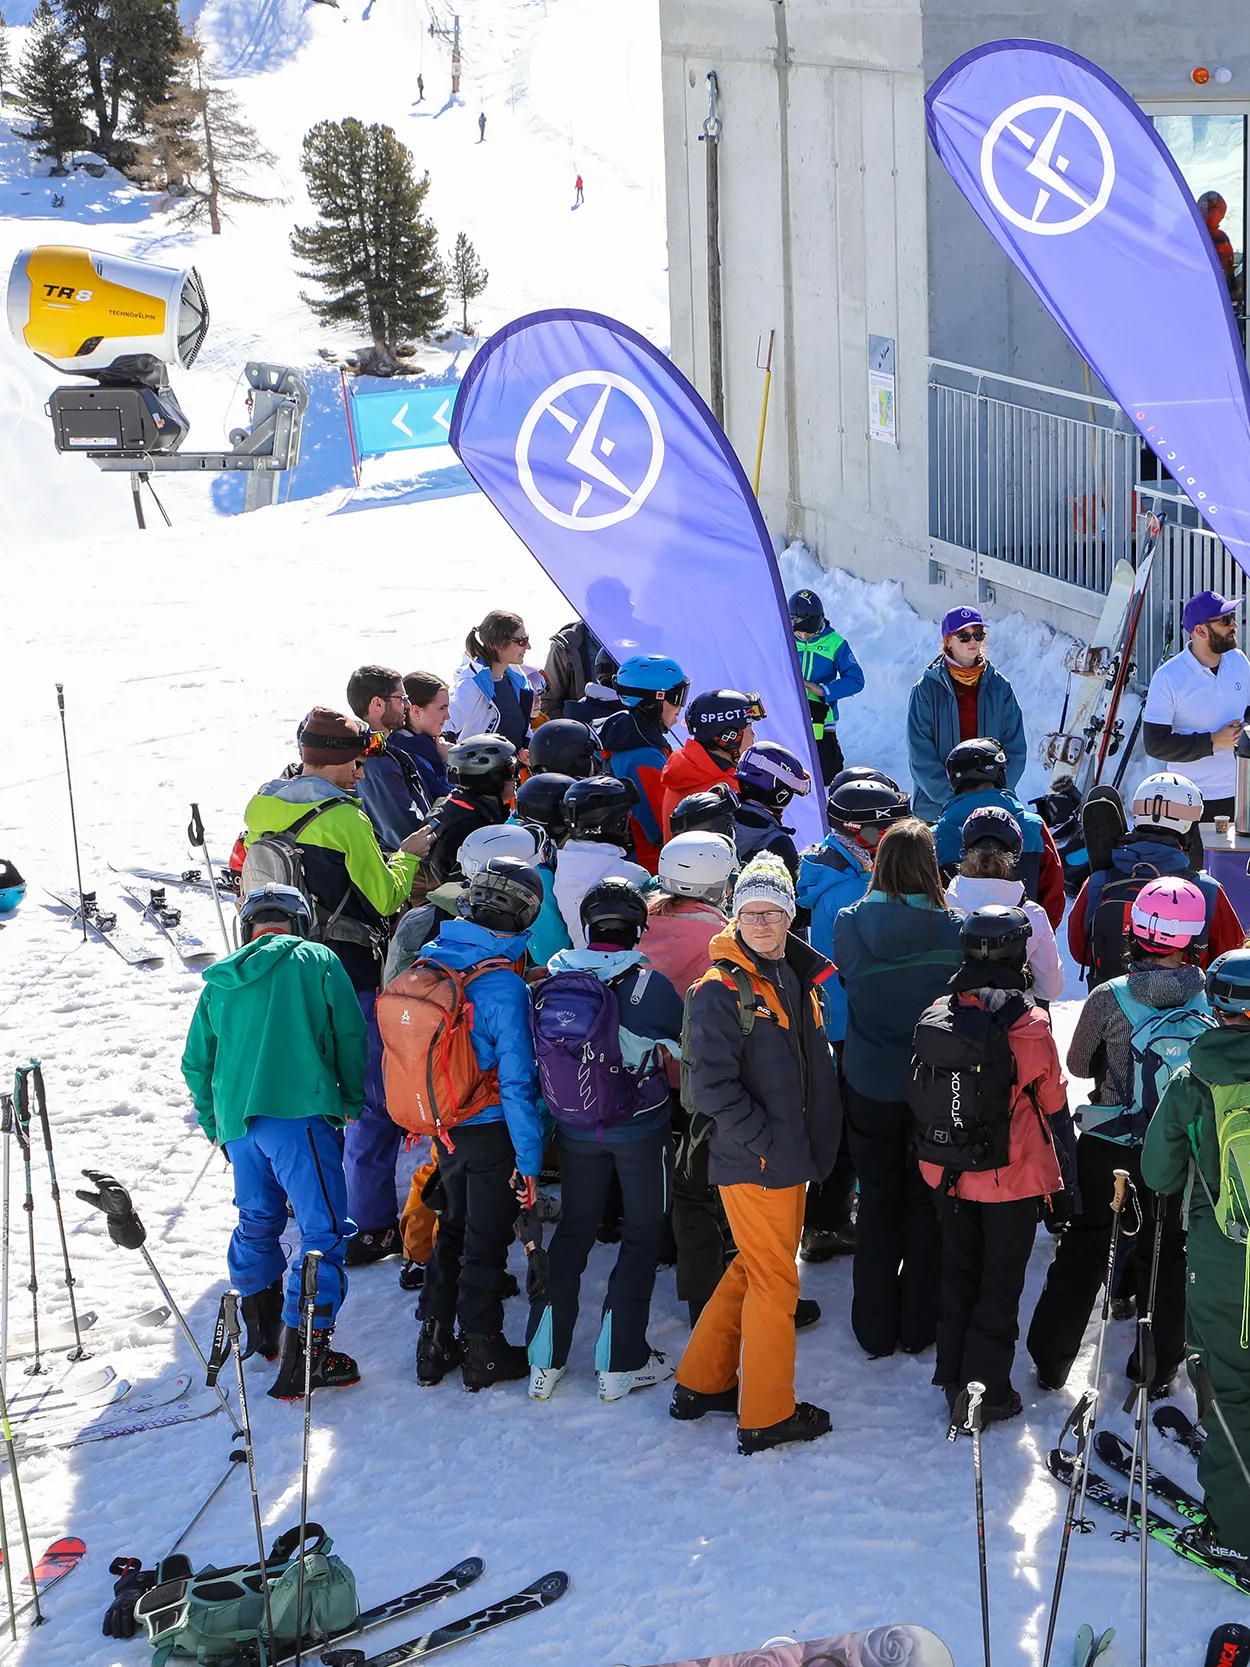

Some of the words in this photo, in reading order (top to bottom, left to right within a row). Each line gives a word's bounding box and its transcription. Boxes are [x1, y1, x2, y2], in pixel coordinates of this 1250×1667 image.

[43, 284, 93, 302] TR8
[700, 709, 741, 723] SPECT
[556, 1010, 577, 1018] OSPREY
[757, 1005, 771, 1016] evoc
[214, 1319, 224, 1348] SCOTT
[326, 1373, 352, 1382] ATOMIC
[972, 1439, 980, 1468] LEKI
